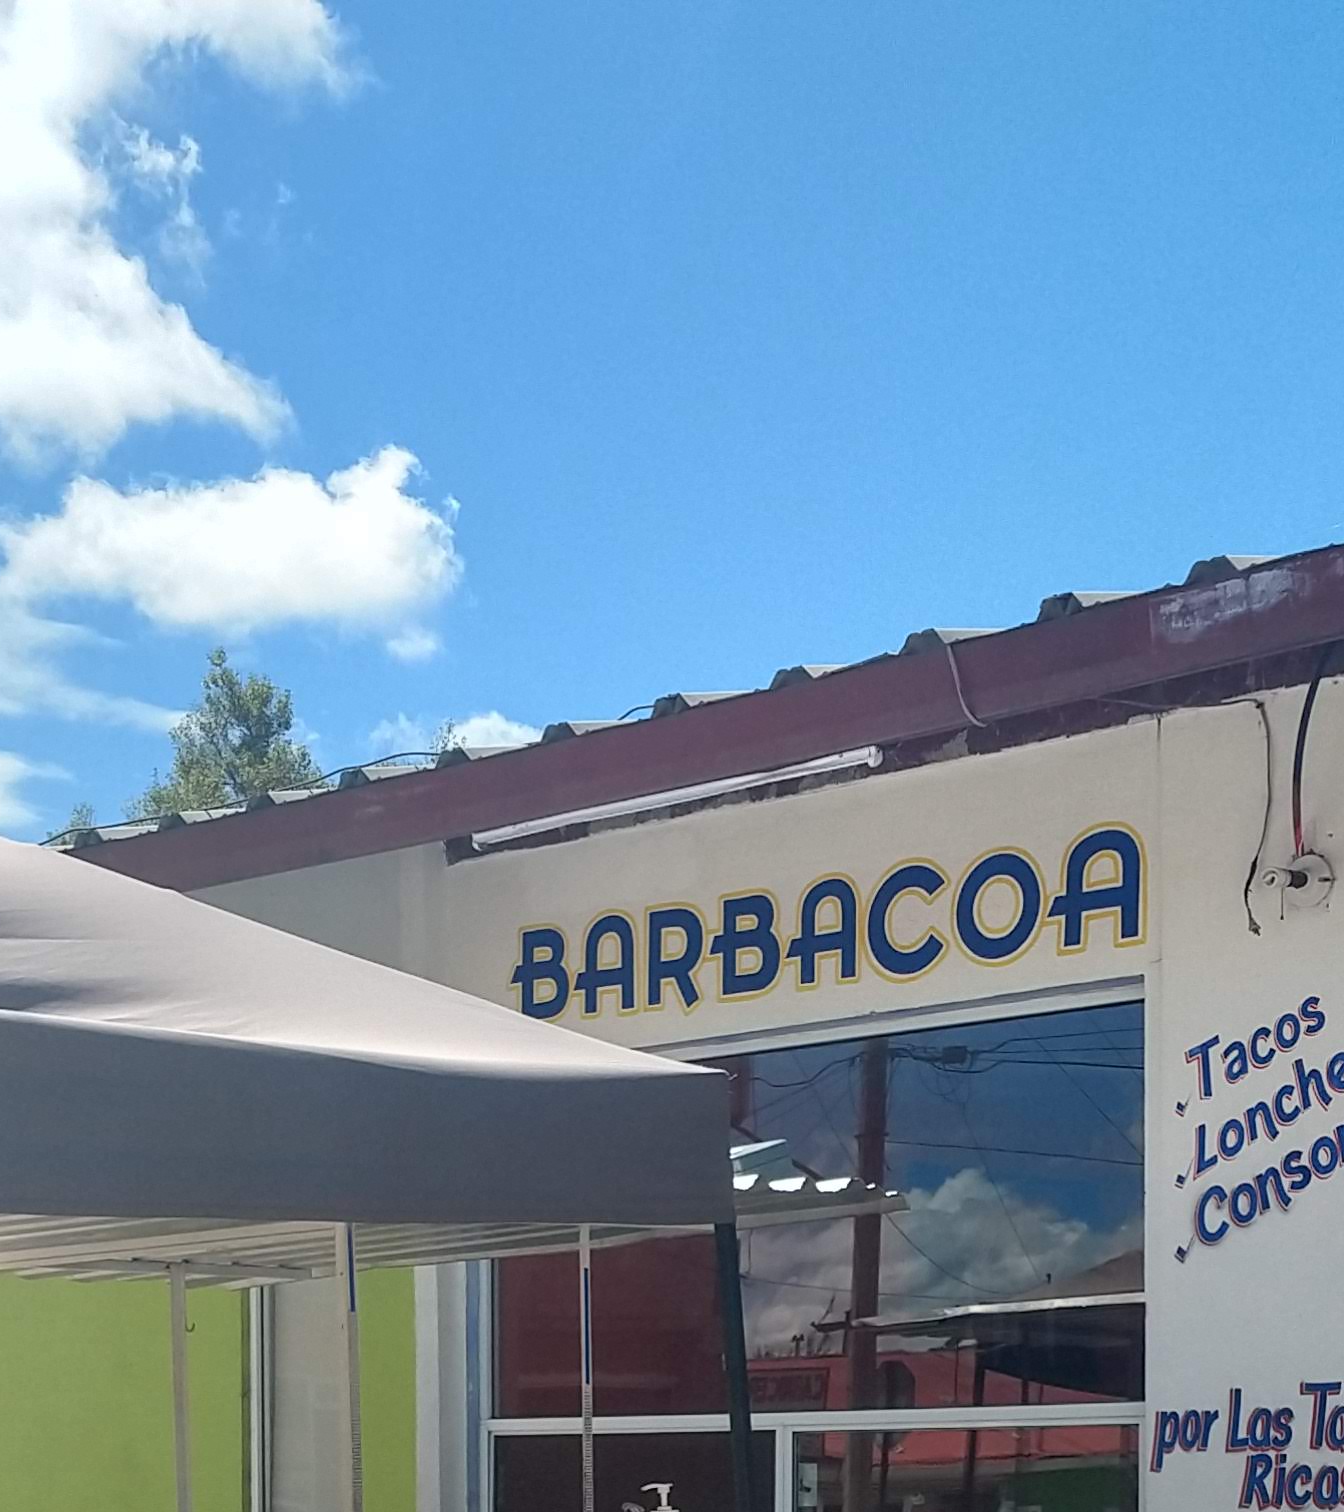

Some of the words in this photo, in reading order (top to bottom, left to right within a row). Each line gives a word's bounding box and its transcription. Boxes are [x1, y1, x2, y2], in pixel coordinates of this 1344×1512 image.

[510, 821, 1150, 1022] BARBACOA
[1184, 995, 1326, 1100] Tacos
[1150, 1408, 1220, 1473] por
[1225, 1386, 1296, 1452] Las
